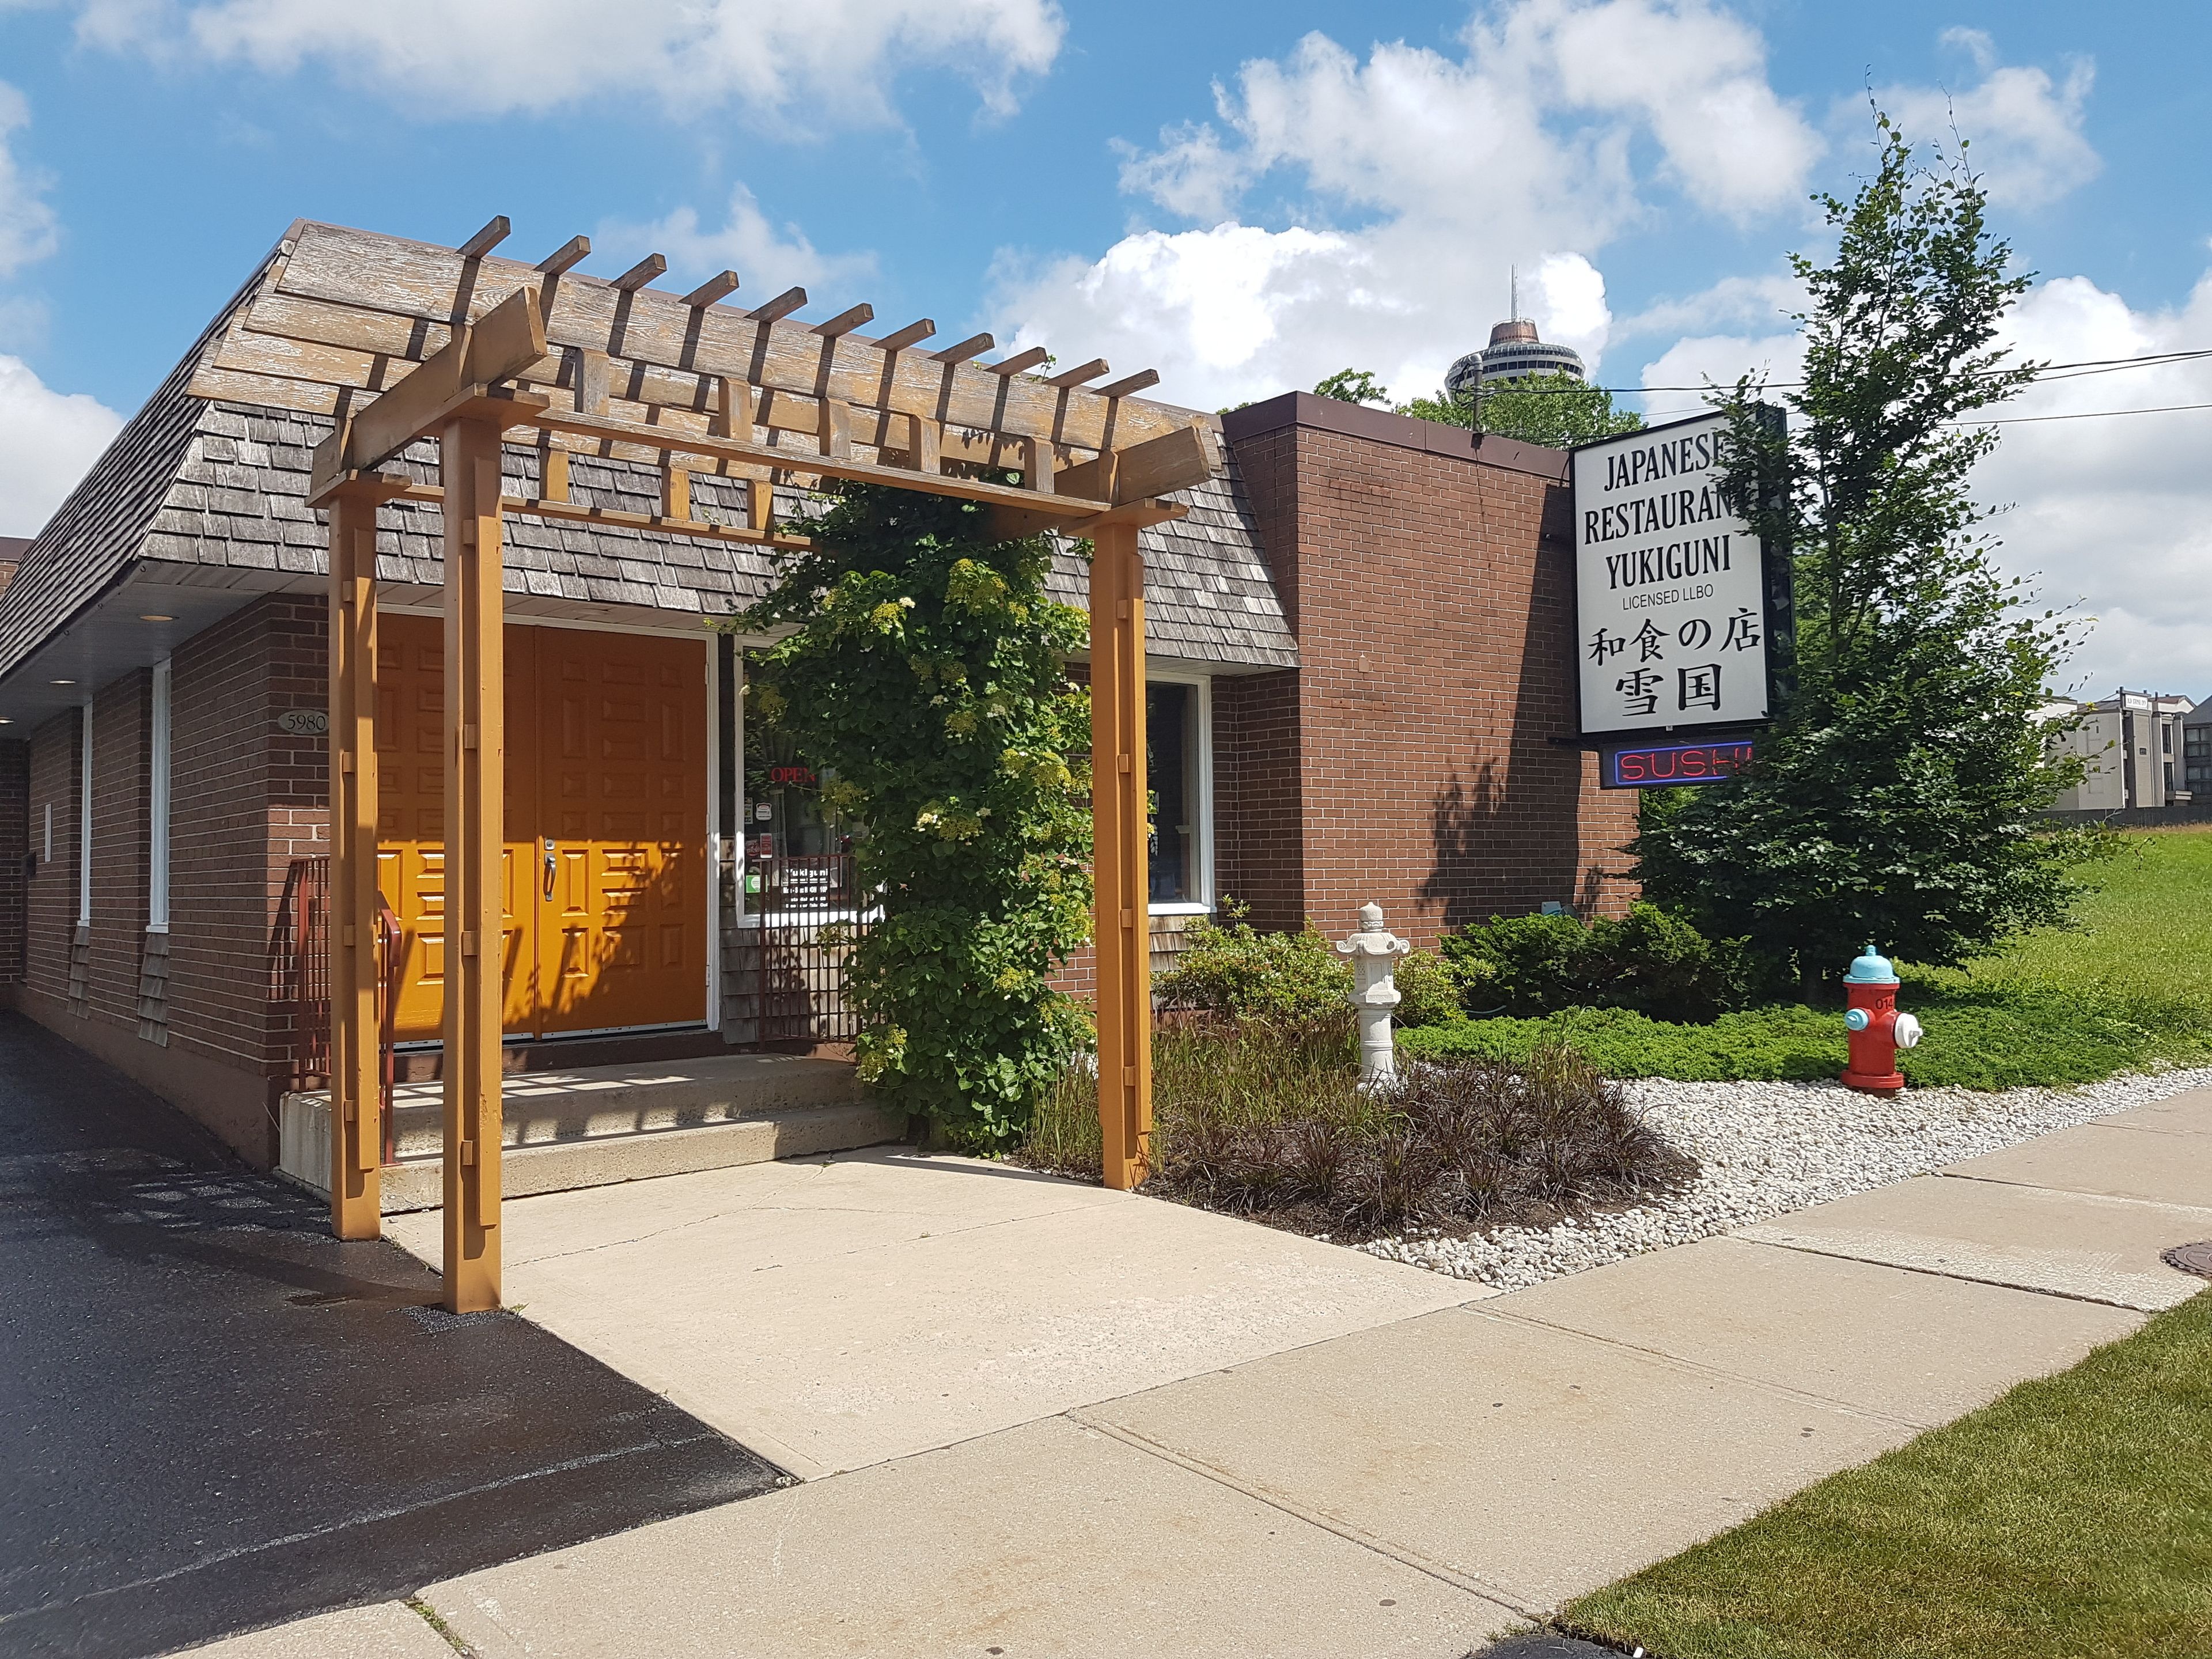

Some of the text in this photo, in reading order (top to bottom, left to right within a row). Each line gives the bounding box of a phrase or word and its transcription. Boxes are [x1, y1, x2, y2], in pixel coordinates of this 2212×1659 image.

[1604, 431, 1724, 492] JAPANESE
[1585, 483, 1735, 545] RESTAURAN
[1605, 534, 1731, 590] YUKIGUNI
[1623, 583, 1714, 611] LICENSED LLBO
[1587, 607, 1761, 666] 和食の店
[1615, 663, 1722, 717] 雪国
[288, 715, 325, 730] 5980
[771, 767, 816, 782] OPEN
[1876, 998, 1893, 1009] 014
